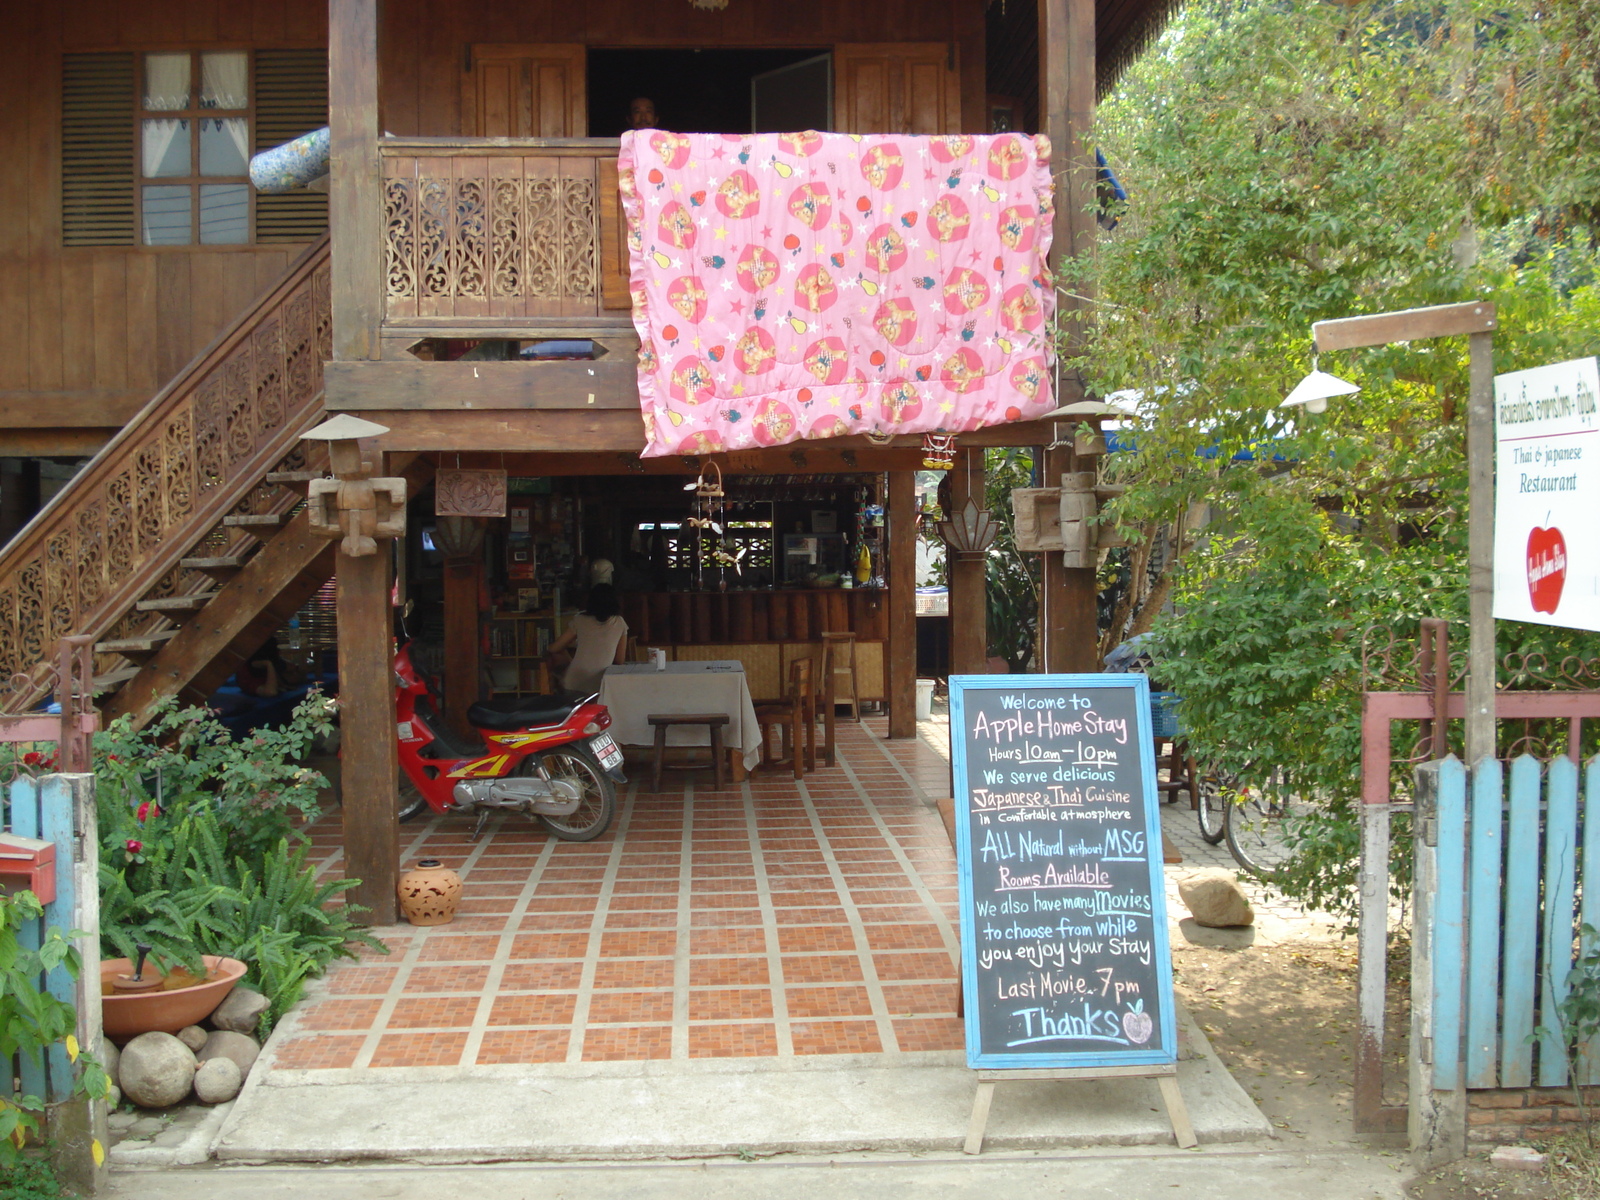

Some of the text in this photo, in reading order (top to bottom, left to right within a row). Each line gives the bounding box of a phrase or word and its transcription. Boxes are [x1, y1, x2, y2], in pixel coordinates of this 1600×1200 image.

[1513, 446, 1532, 464] Thai
[1544, 445, 1583, 468] japanese
[1519, 472, 1578, 493] Restaurant
[1000, 693, 1091, 710] Welcome to
[973, 710, 1035, 744] Apple
[988, 746, 1022, 762] Hours
[983, 766, 1116, 785] We serve delicious
[972, 788, 1042, 811] Japanese
[1047, 785, 1082, 805] Thai
[1085, 786, 1130, 803] Cuisine
[1060, 806, 1131, 824] atmosphere
[980, 828, 1145, 863] ALL Natural without MSG
[999, 863, 1109, 888] Rooms Available
[976, 900, 997, 917] We
[1000, 893, 1030, 914] also
[1033, 890, 1061, 912] have
[1062, 897, 1096, 917] many
[983, 914, 1138, 940] to choose from while
[979, 948, 1013, 969] you
[1015, 939, 1065, 969] enjoy
[1068, 940, 1104, 965] your
[998, 977, 1036, 1000] Last
